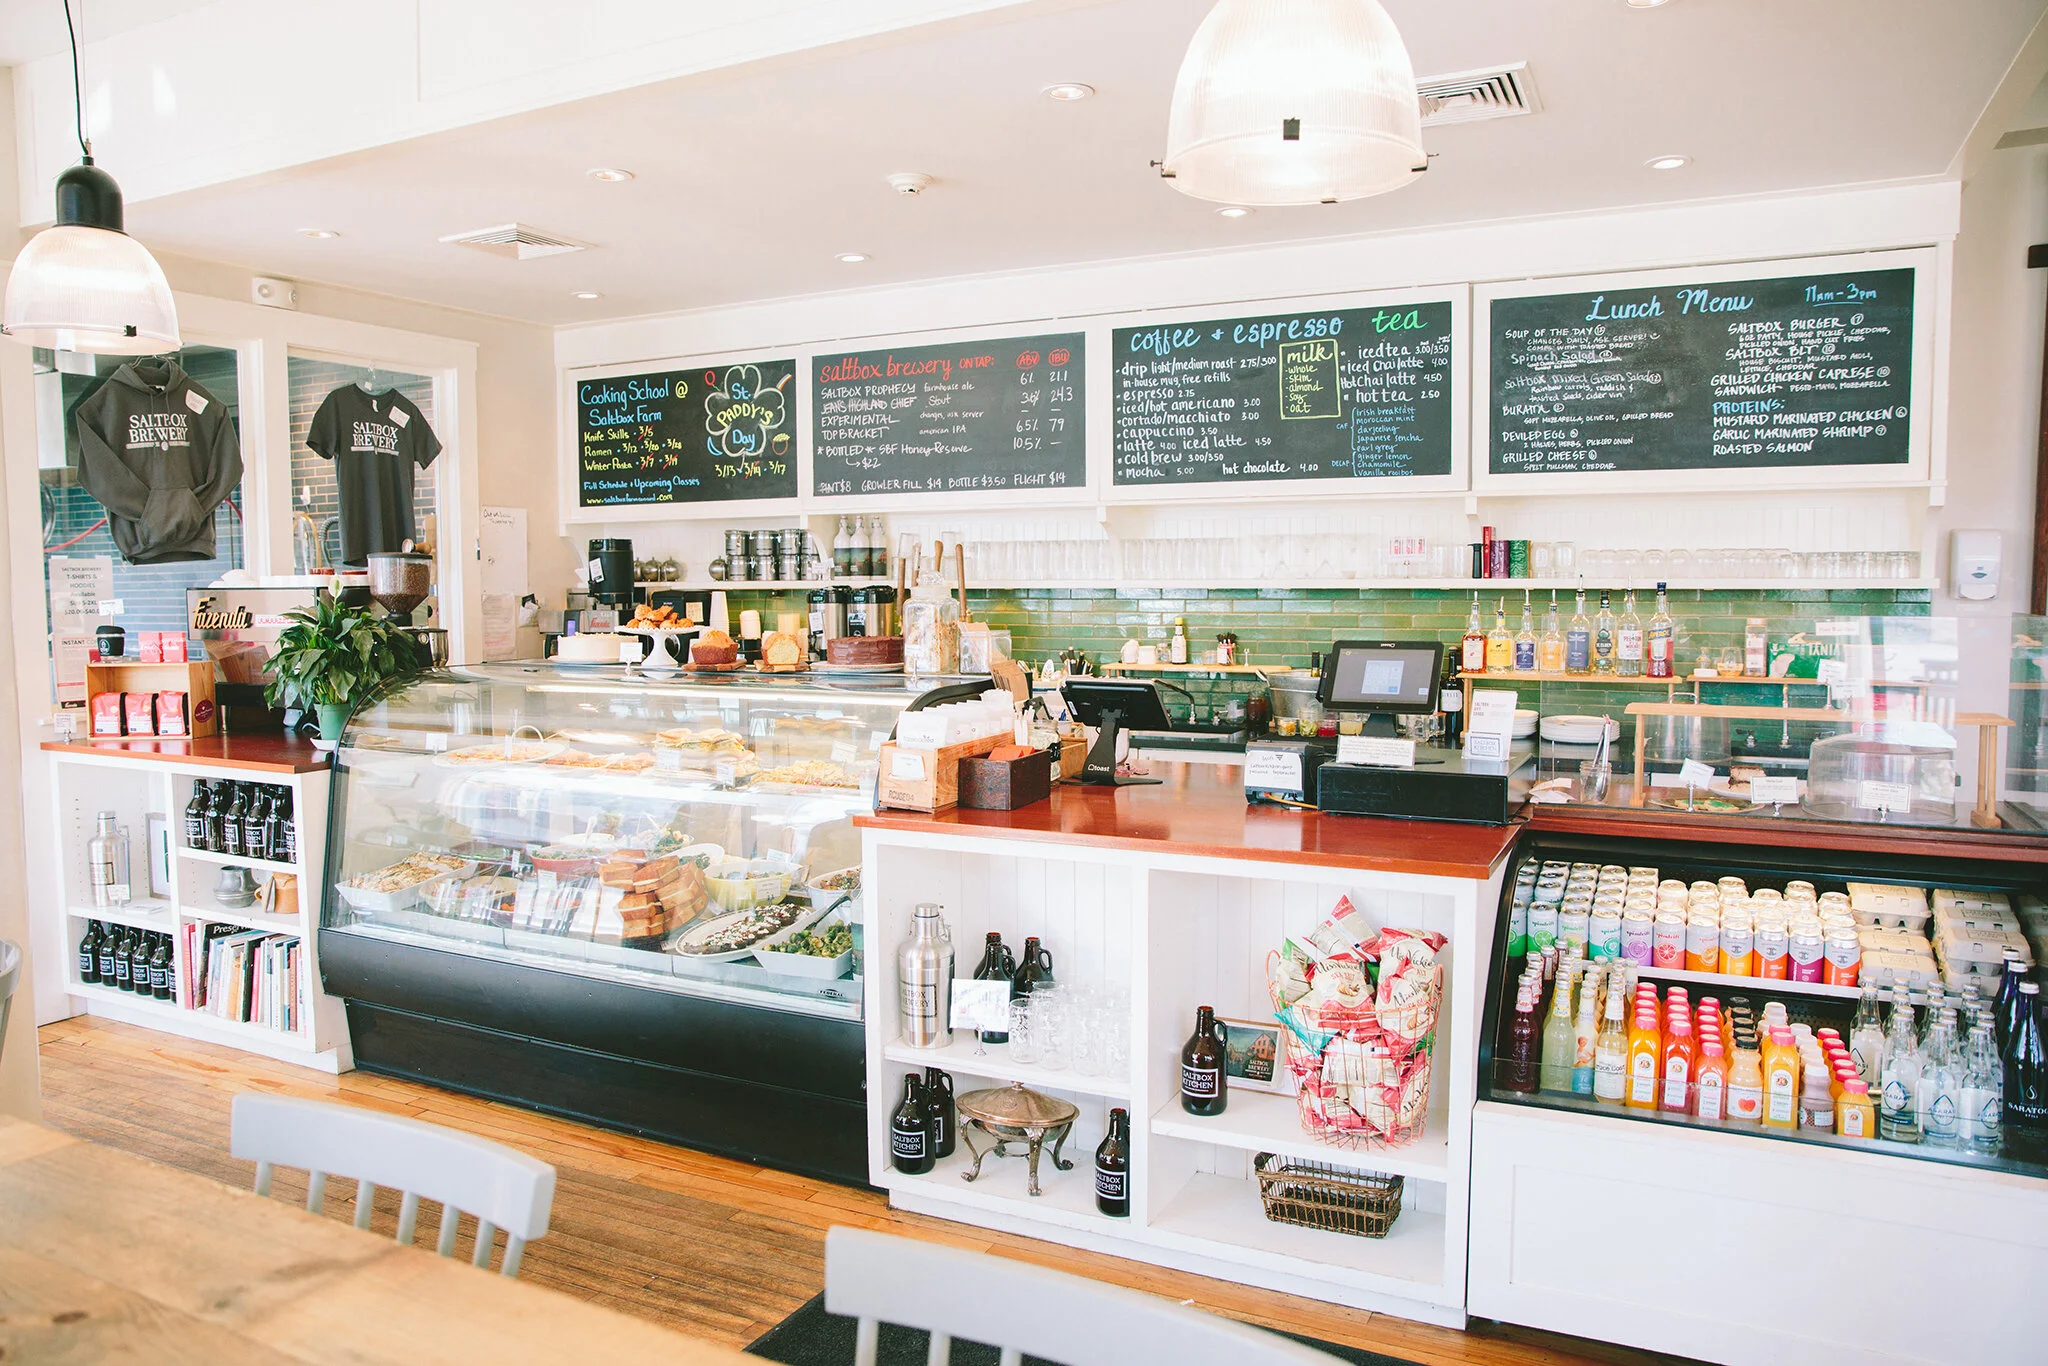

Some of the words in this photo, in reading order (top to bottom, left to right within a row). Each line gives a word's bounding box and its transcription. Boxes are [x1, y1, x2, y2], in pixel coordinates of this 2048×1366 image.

[1585, 295, 1665, 321] Lunch
[1676, 289, 1754, 314] Menu
[1371, 310, 1428, 333] tea
[1728, 321, 1785, 335] SALTBOX
[1790, 317, 1847, 331] BURGER
[1130, 328, 1201, 357] coffee
[1233, 317, 1345, 348] espresso
[1505, 329, 1529, 339] SOUP
[1534, 328, 1546, 337] OF
[1550, 327, 1570, 336] THE
[1573, 327, 1593, 336] DAY
[1287, 342, 1333, 364] milk
[1358, 345, 1385, 359] iced
[1386, 342, 1412, 357] tea
[1511, 351, 1558, 365] Spinach
[1562, 350, 1596, 361] Salad
[1725, 347, 1783, 361] SALTBOX
[1789, 344, 1819, 357] BLT
[819, 357, 882, 383] saltbox
[886, 354, 953, 381] brewery
[1121, 361, 1148, 378] drip
[1211, 357, 1237, 370] roast
[1288, 364, 1318, 374] whole
[1182, 374, 1201, 385] free
[1203, 372, 1231, 383] refills
[1288, 374, 1313, 383] skim
[1386, 372, 1417, 387] latte
[1551, 372, 1588, 384] Mixed
[1590, 373, 1626, 384] Green
[1710, 373, 1761, 386] GRILLED
[1763, 370, 1814, 384] CHICKEN
[1818, 366, 1875, 380] CAPRESE
[731, 383, 752, 400] St.
[821, 386, 862, 399] SALTBOX
[864, 383, 916, 397] PROPHECY
[961, 381, 975, 391] ale
[1049, 371, 1068, 383] 21.1
[1288, 381, 1324, 391] almond
[1714, 383, 1783, 397] SANDWICH
[580, 384, 628, 411] Cooking
[628, 378, 669, 401] School
[675, 380, 689, 399] @
[848, 398, 888, 413] HIGHLAND
[890, 396, 918, 410] CHIEF
[1050, 387, 1073, 402] 24.3
[1123, 388, 1174, 406] espresso
[1289, 391, 1307, 404] soy
[1356, 389, 1381, 403] hot
[1381, 388, 1414, 402] tea
[1122, 402, 1168, 415] iced/hot
[1171, 397, 1236, 411] americano
[1289, 403, 1312, 413] oat
[1356, 407, 1376, 417] irish
[1377, 406, 1416, 416] breakfast
[1712, 398, 1786, 416] PROTEINS:
[129, 413, 187, 429] SALTBOX
[588, 408, 635, 427] Saltbox
[636, 404, 663, 422] Farm
[716, 402, 774, 428] PADDY'S
[821, 413, 901, 427] EXPERIMENTAL
[962, 411, 984, 419] server
[1121, 411, 1231, 428] cortado/macchiato
[1713, 413, 1770, 427] MUSTARD
[1773, 411, 1837, 425] MARINATED
[1839, 406, 1894, 422] CHICKEN
[353, 421, 399, 438] SALTBOX
[952, 424, 967, 434] IPA
[1048, 418, 1065, 432] 79
[1122, 426, 1195, 440] cappuccino
[1712, 428, 1751, 441] GARLIC
[1754, 426, 1819, 440] MARINATED
[1822, 425, 1875, 438] SHRIMP
[128, 427, 188, 443] BREWERY
[352, 433, 398, 450] BREWERY
[584, 430, 605, 443] Knife
[607, 428, 630, 440] Skills
[732, 429, 756, 452] Day
[1123, 438, 1156, 452] latte
[1182, 435, 1210, 450] iced
[1213, 434, 1248, 448] latte
[1502, 431, 1543, 442] DEVILED
[1543, 429, 1566, 439] EGG
[584, 446, 612, 457] Ramen
[622, 442, 638, 454] 3/12
[1713, 443, 1763, 456] ROASTED
[1766, 440, 1815, 452] SALMON
[584, 460, 612, 471] Winter
[612, 457, 633, 470] Pasta
[861, 457, 881, 470] $22
[1124, 451, 1149, 465] cold
[1151, 451, 1182, 465] brew
[1502, 451, 1544, 464] GRILLED
[1547, 450, 1587, 461] CHEESE
[768, 461, 787, 475] 3/17
[1125, 466, 1166, 478] mocha
[1222, 462, 1239, 475] hot
[1243, 459, 1291, 474] chocolate
[583, 481, 598, 490] Full
[633, 478, 672, 493] Upcoming
[672, 475, 700, 486] Classes
[861, 479, 902, 492] GROWLER
[903, 479, 922, 490] FILL
[948, 476, 979, 488] BOTTLE
[1013, 473, 1047, 486] FLIGHT
